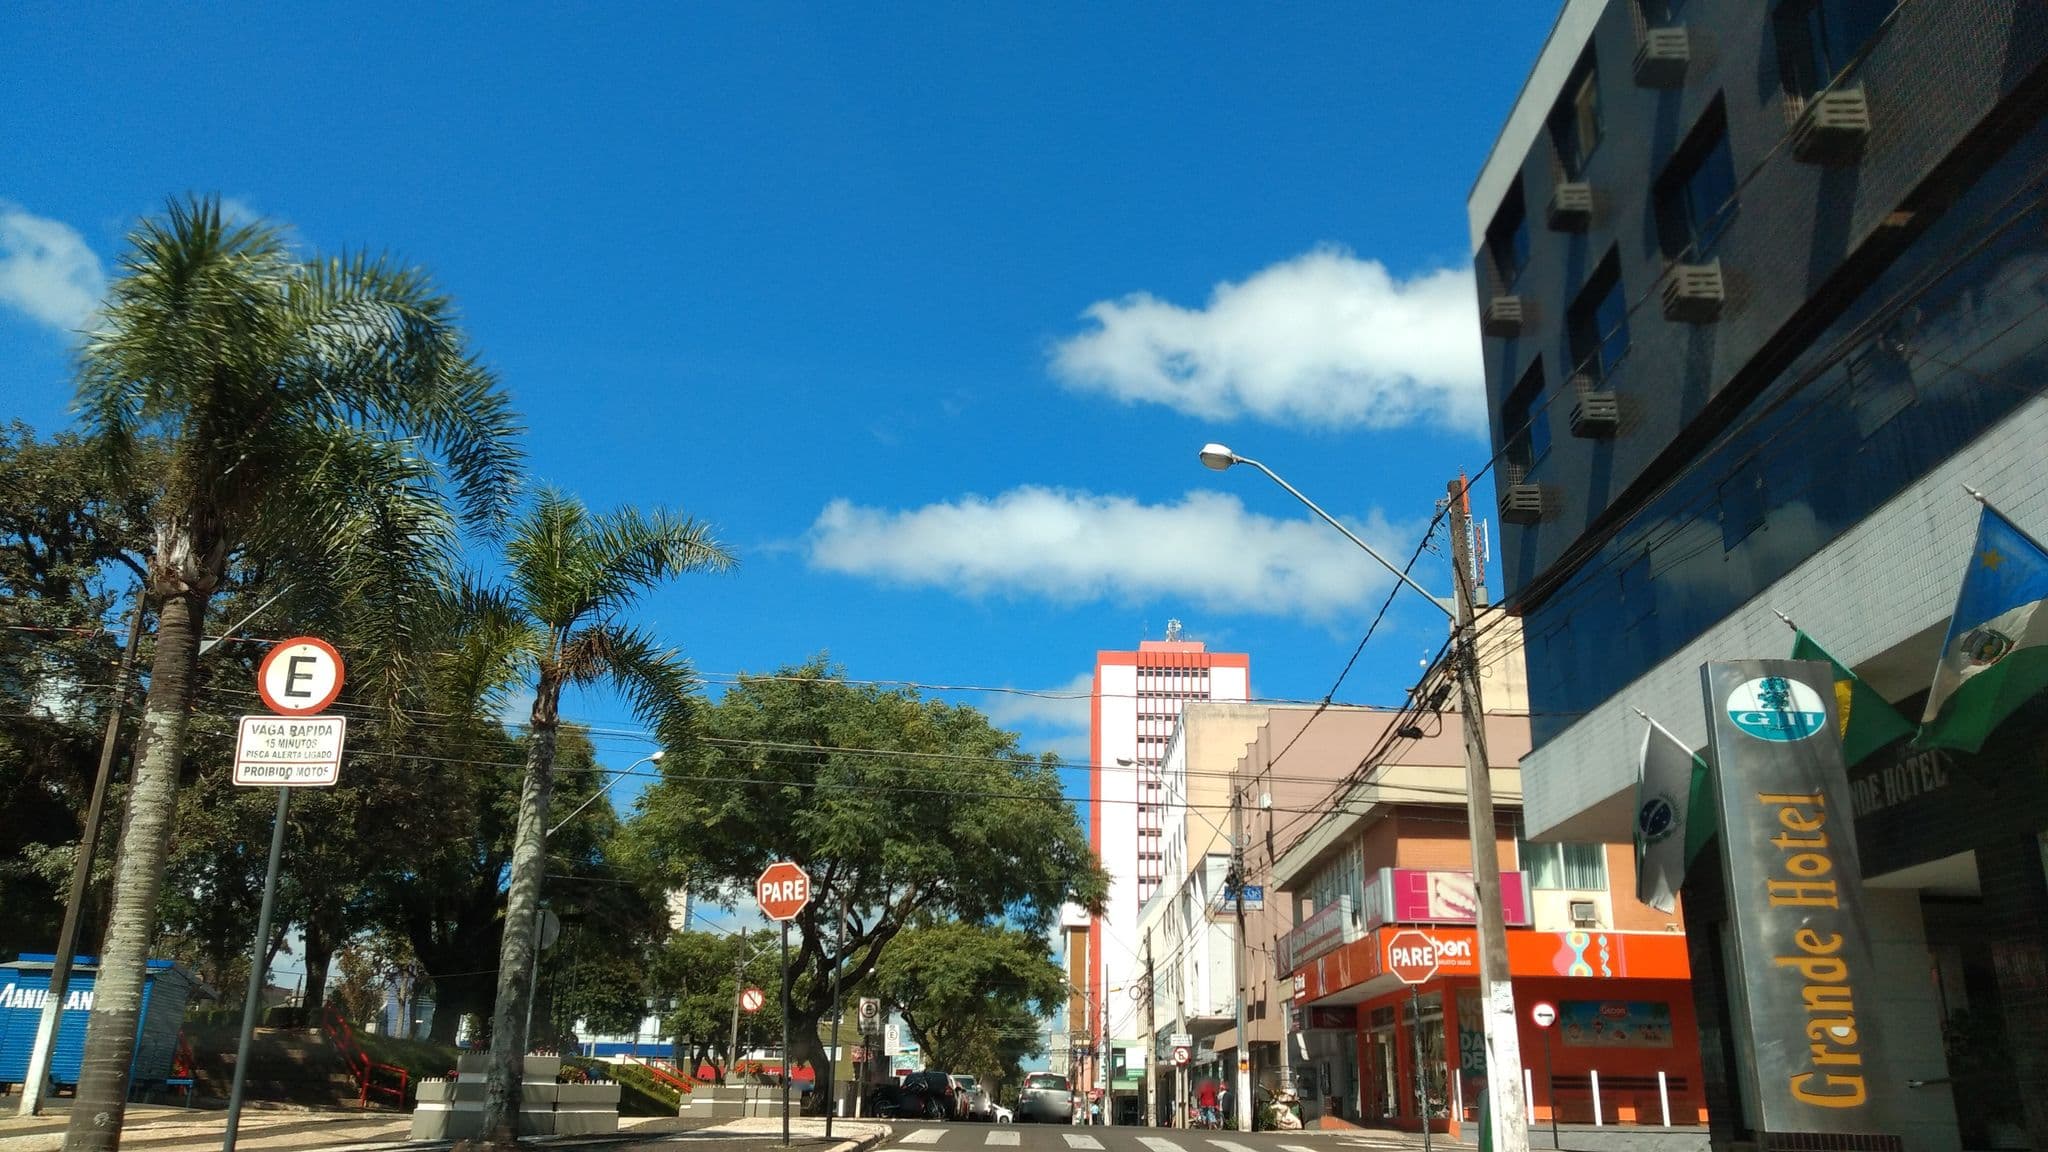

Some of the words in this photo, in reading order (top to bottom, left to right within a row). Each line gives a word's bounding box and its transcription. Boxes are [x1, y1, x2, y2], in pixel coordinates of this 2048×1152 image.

[284, 656, 317, 698] E
[252, 724, 285, 736] VAGA
[289, 724, 333, 737] RAPIDA
[246, 750, 270, 759] PISCA
[272, 750, 302, 759] ALERTA
[304, 750, 332, 759] LIGADO
[266, 739, 276, 748] 15
[278, 739, 318, 749] MINUTOS
[244, 766, 293, 778] PROIBIDO
[296, 766, 329, 777] MOTOS
[1883, 750, 1947, 807] HOTEL
[1756, 789, 1840, 911] Hotel
[762, 879, 805, 904] PARE
[1392, 946, 1434, 967] PARE
[1773, 928, 1868, 1109] Grande
